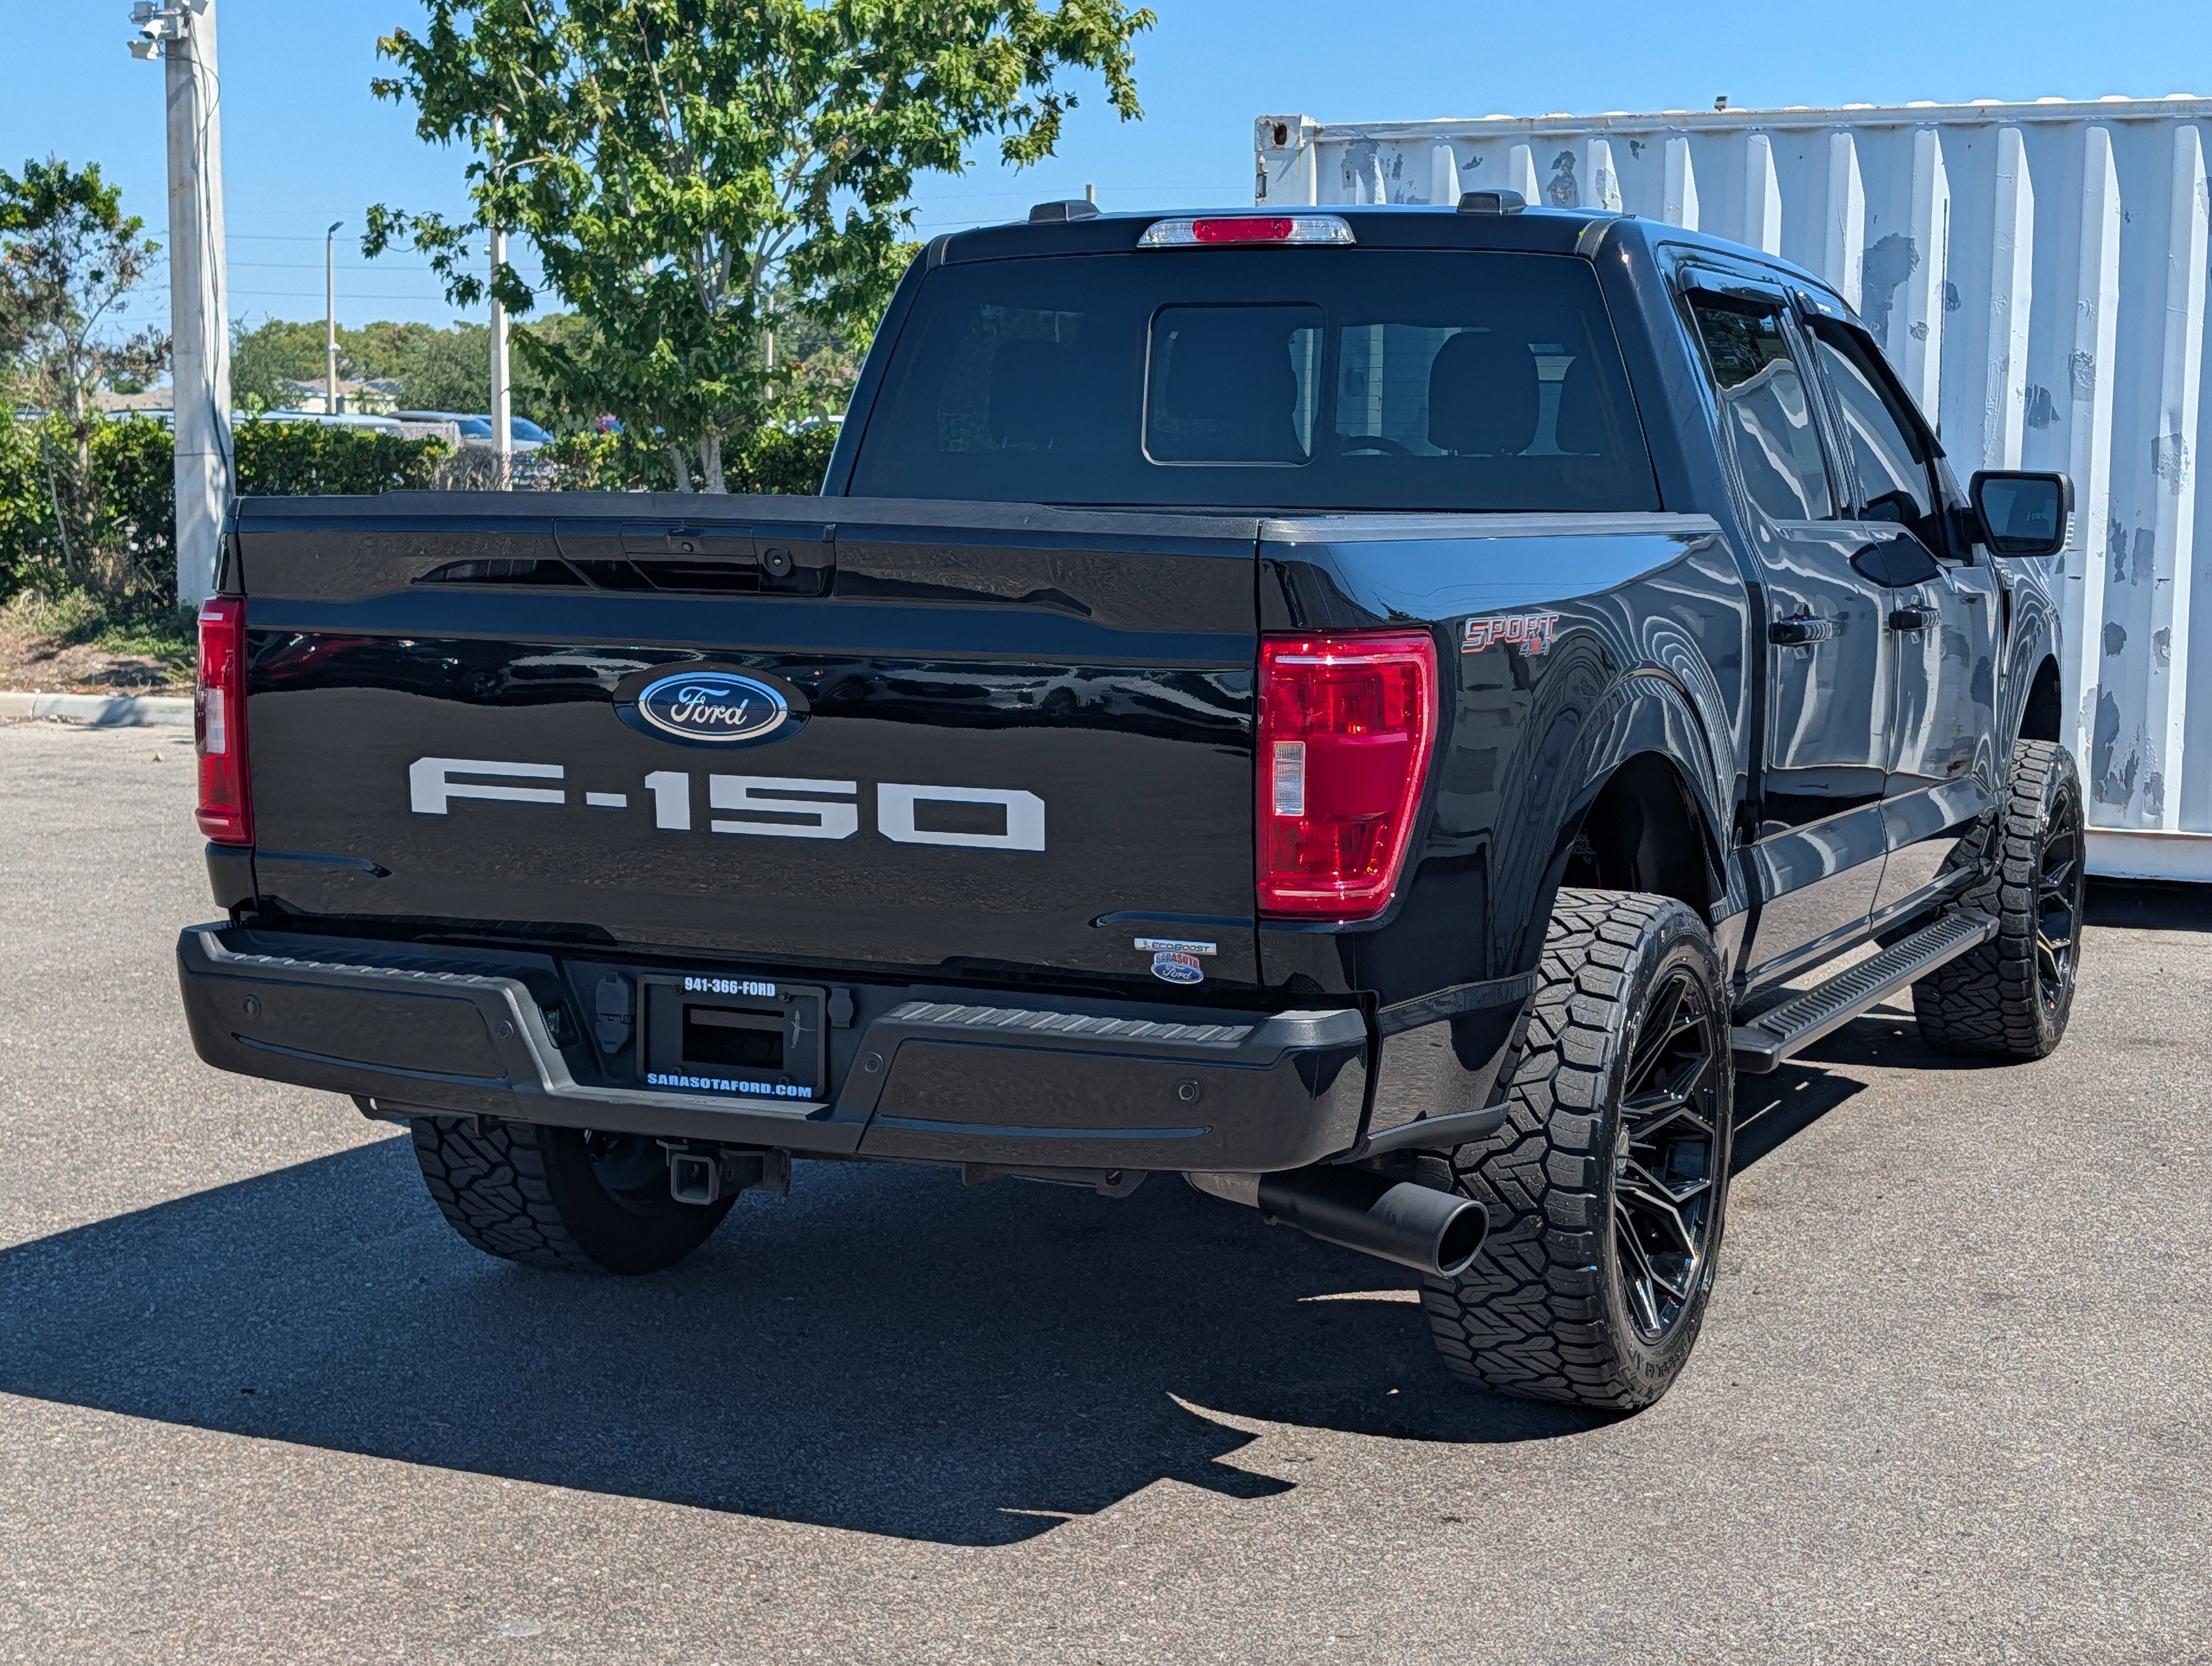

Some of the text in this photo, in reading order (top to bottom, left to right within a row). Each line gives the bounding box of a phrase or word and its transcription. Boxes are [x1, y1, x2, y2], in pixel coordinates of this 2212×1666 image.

[1461, 611, 1561, 653] SPORT
[670, 686, 750, 727] Ford
[409, 757, 1045, 851] F-150
[684, 977, 776, 997] 941-366-FORD
[1162, 964, 1192, 979] Ford
[647, 1073, 812, 1098] SARASOTAFORD.COM
